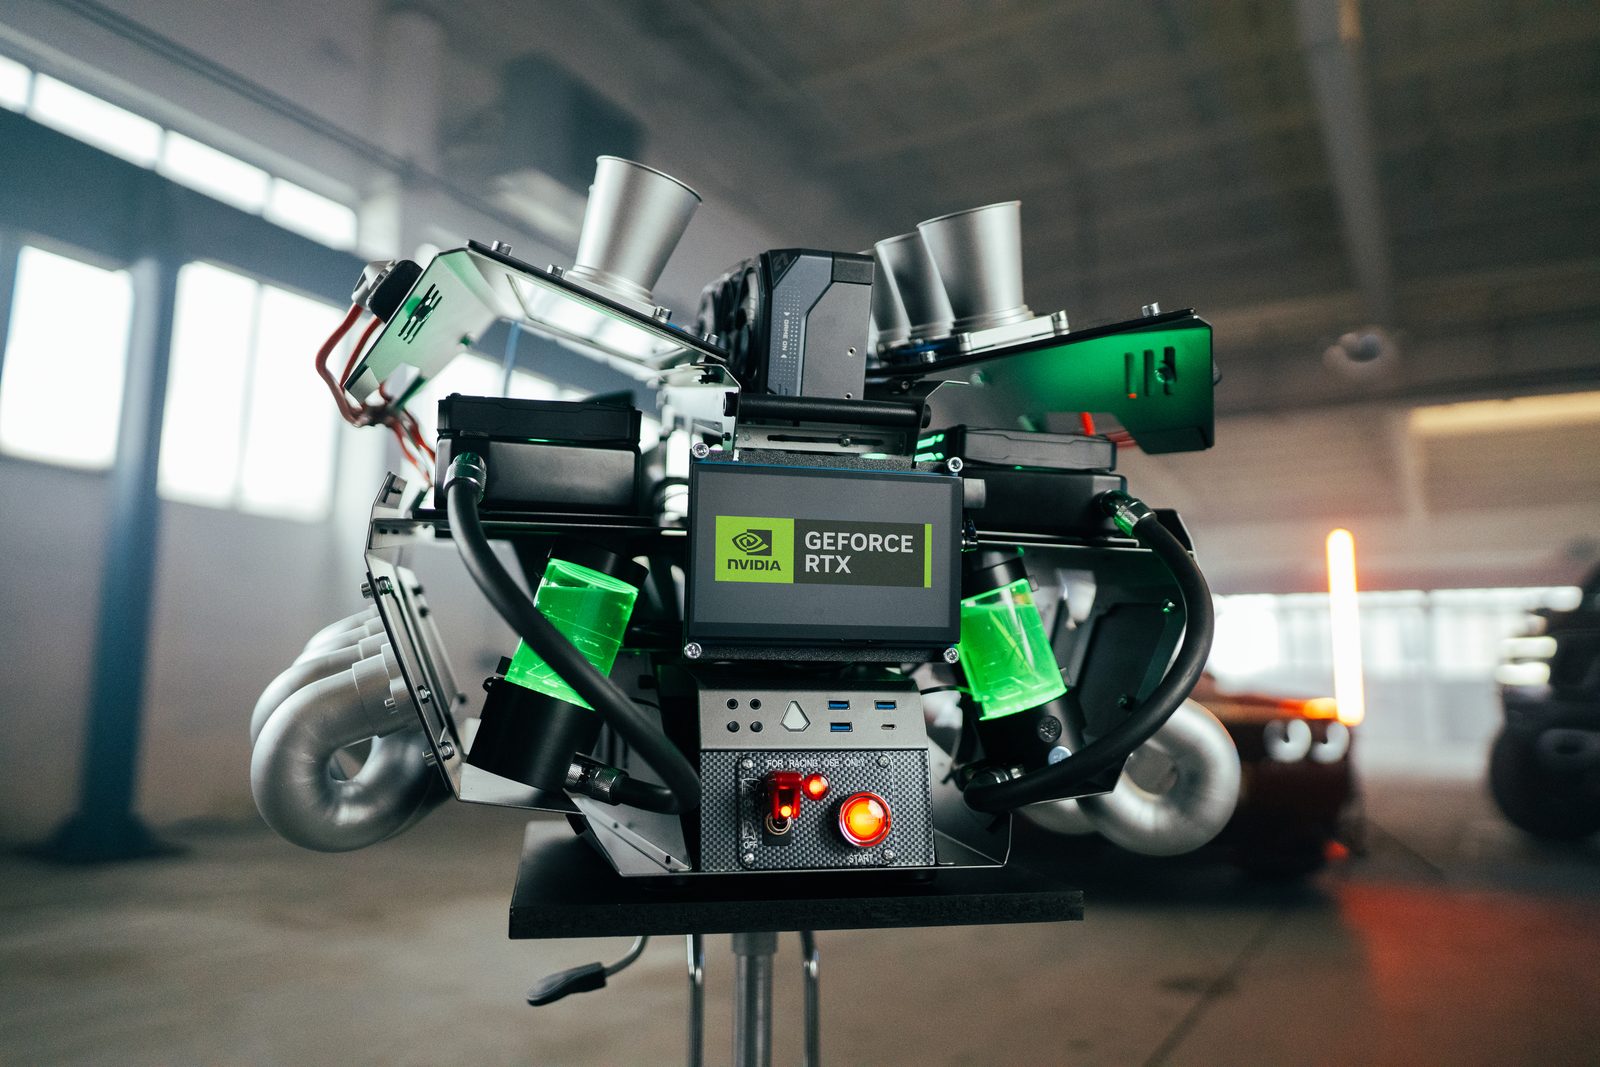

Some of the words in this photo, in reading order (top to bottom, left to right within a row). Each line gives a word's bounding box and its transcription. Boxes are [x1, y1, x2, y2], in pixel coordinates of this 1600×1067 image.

[804, 531, 914, 553] GEFORCE
[727, 558, 782, 572] NVIDIA
[804, 554, 852, 574] RTX
[767, 759, 784, 768] FOR
[789, 758, 819, 768] RACING
[823, 758, 839, 768] USE
[844, 757, 865, 767] ONLY
[743, 841, 758, 850] OFF
[848, 853, 874, 865] START
